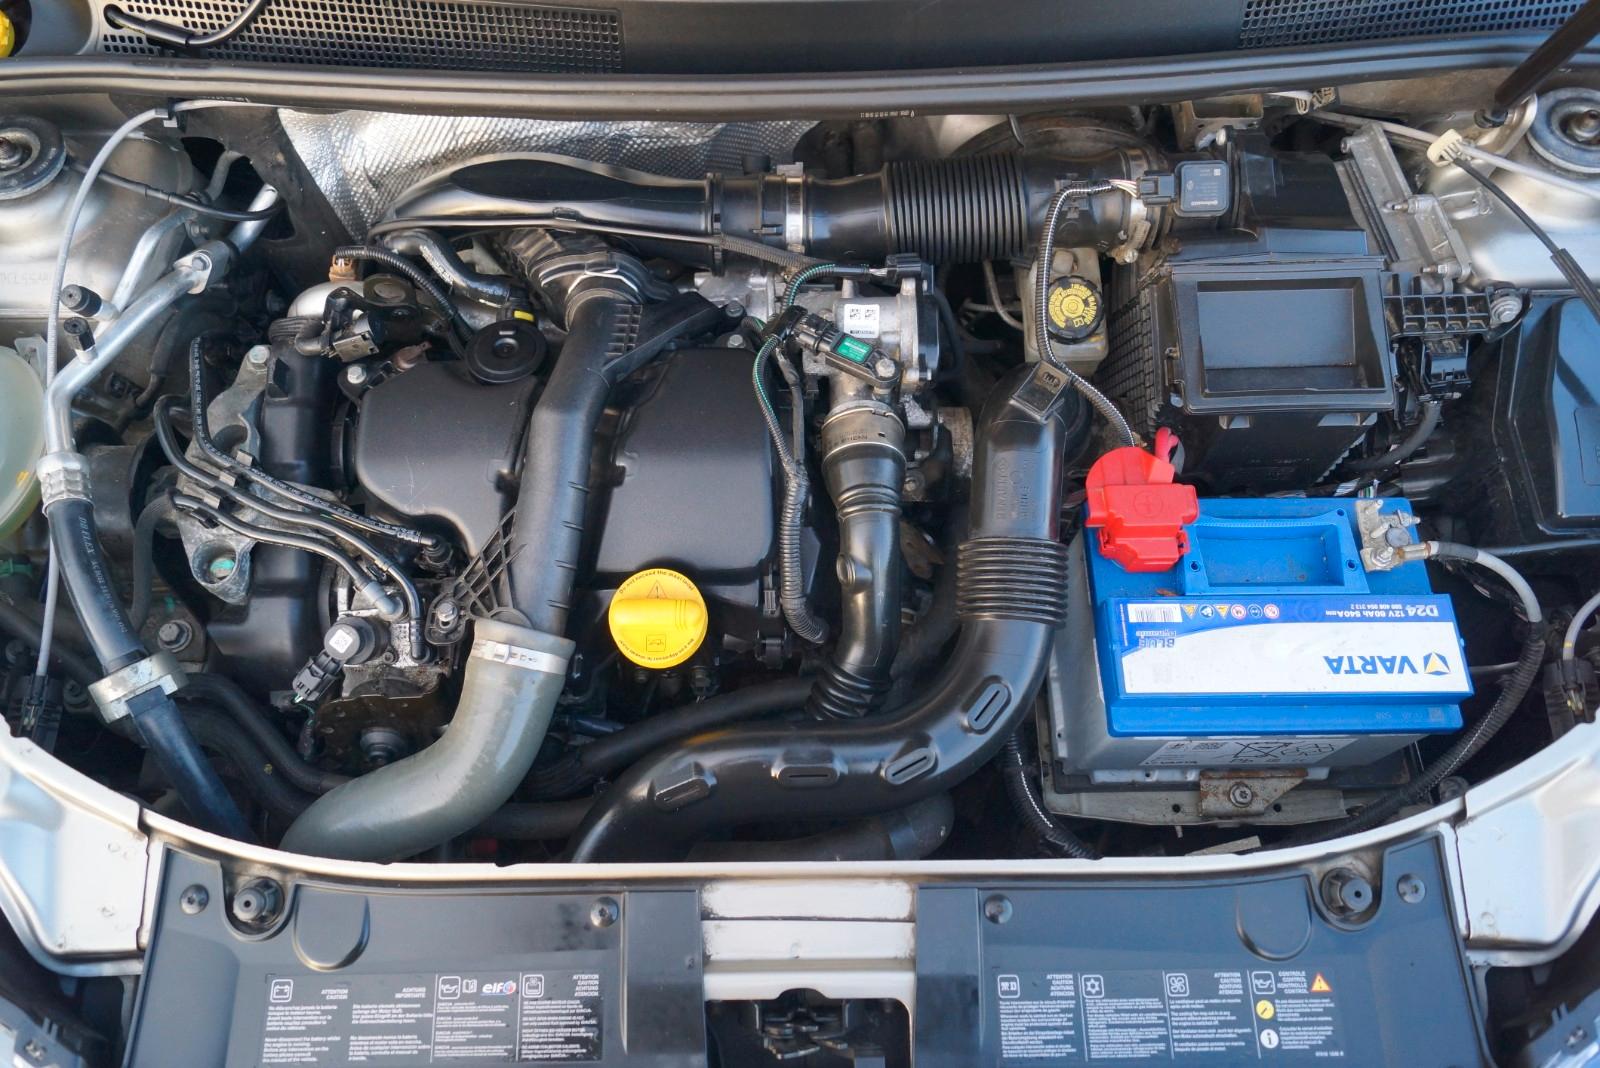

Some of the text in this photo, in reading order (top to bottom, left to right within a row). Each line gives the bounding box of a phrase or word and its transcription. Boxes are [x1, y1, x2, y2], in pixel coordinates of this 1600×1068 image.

[1406, 604, 1439, 617] D24
[1139, 638, 1176, 648] BLUE
[1323, 655, 1418, 675] VARTA
[482, 982, 504, 993] elf
